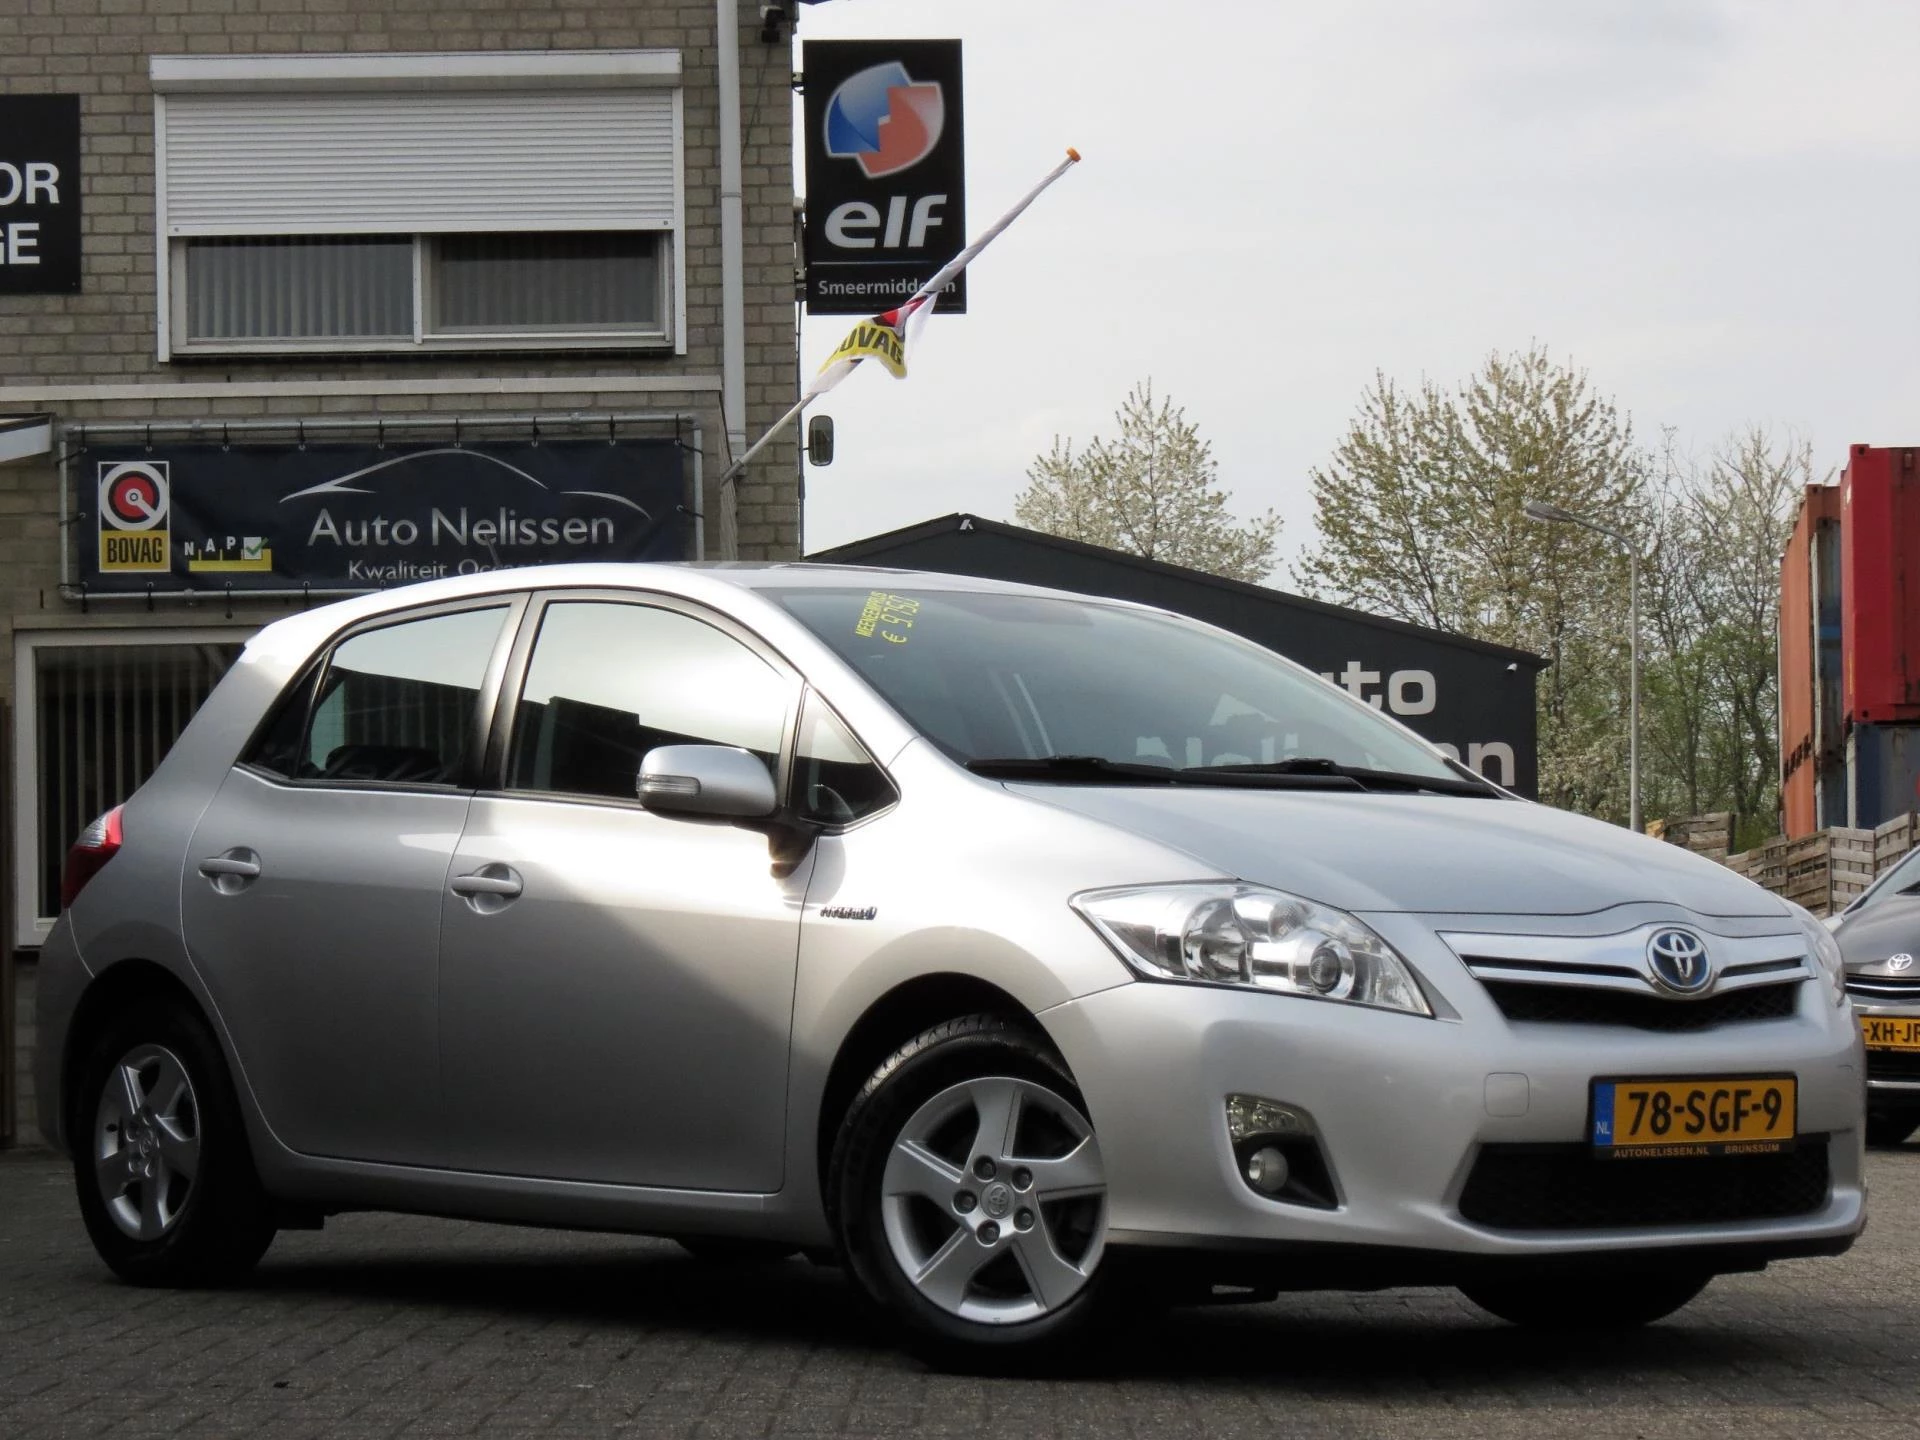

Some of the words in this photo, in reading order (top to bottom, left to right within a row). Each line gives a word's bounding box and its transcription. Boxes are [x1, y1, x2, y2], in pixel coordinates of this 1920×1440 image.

[824, 194, 948, 249] elf
[0, 222, 41, 265] E
[307, 507, 418, 547] Auto
[431, 506, 615, 546] Nelissen
[107, 537, 163, 564] BOVAG
[349, 559, 448, 580] Kwaliteit
[1596, 1121, 1611, 1135] NL
[1628, 1087, 1782, 1136] 78-SGF-9
[1613, 1145, 1710, 1159] AUTONELISSEN.NL
[1724, 1143, 1780, 1154] BRUNSSUM
